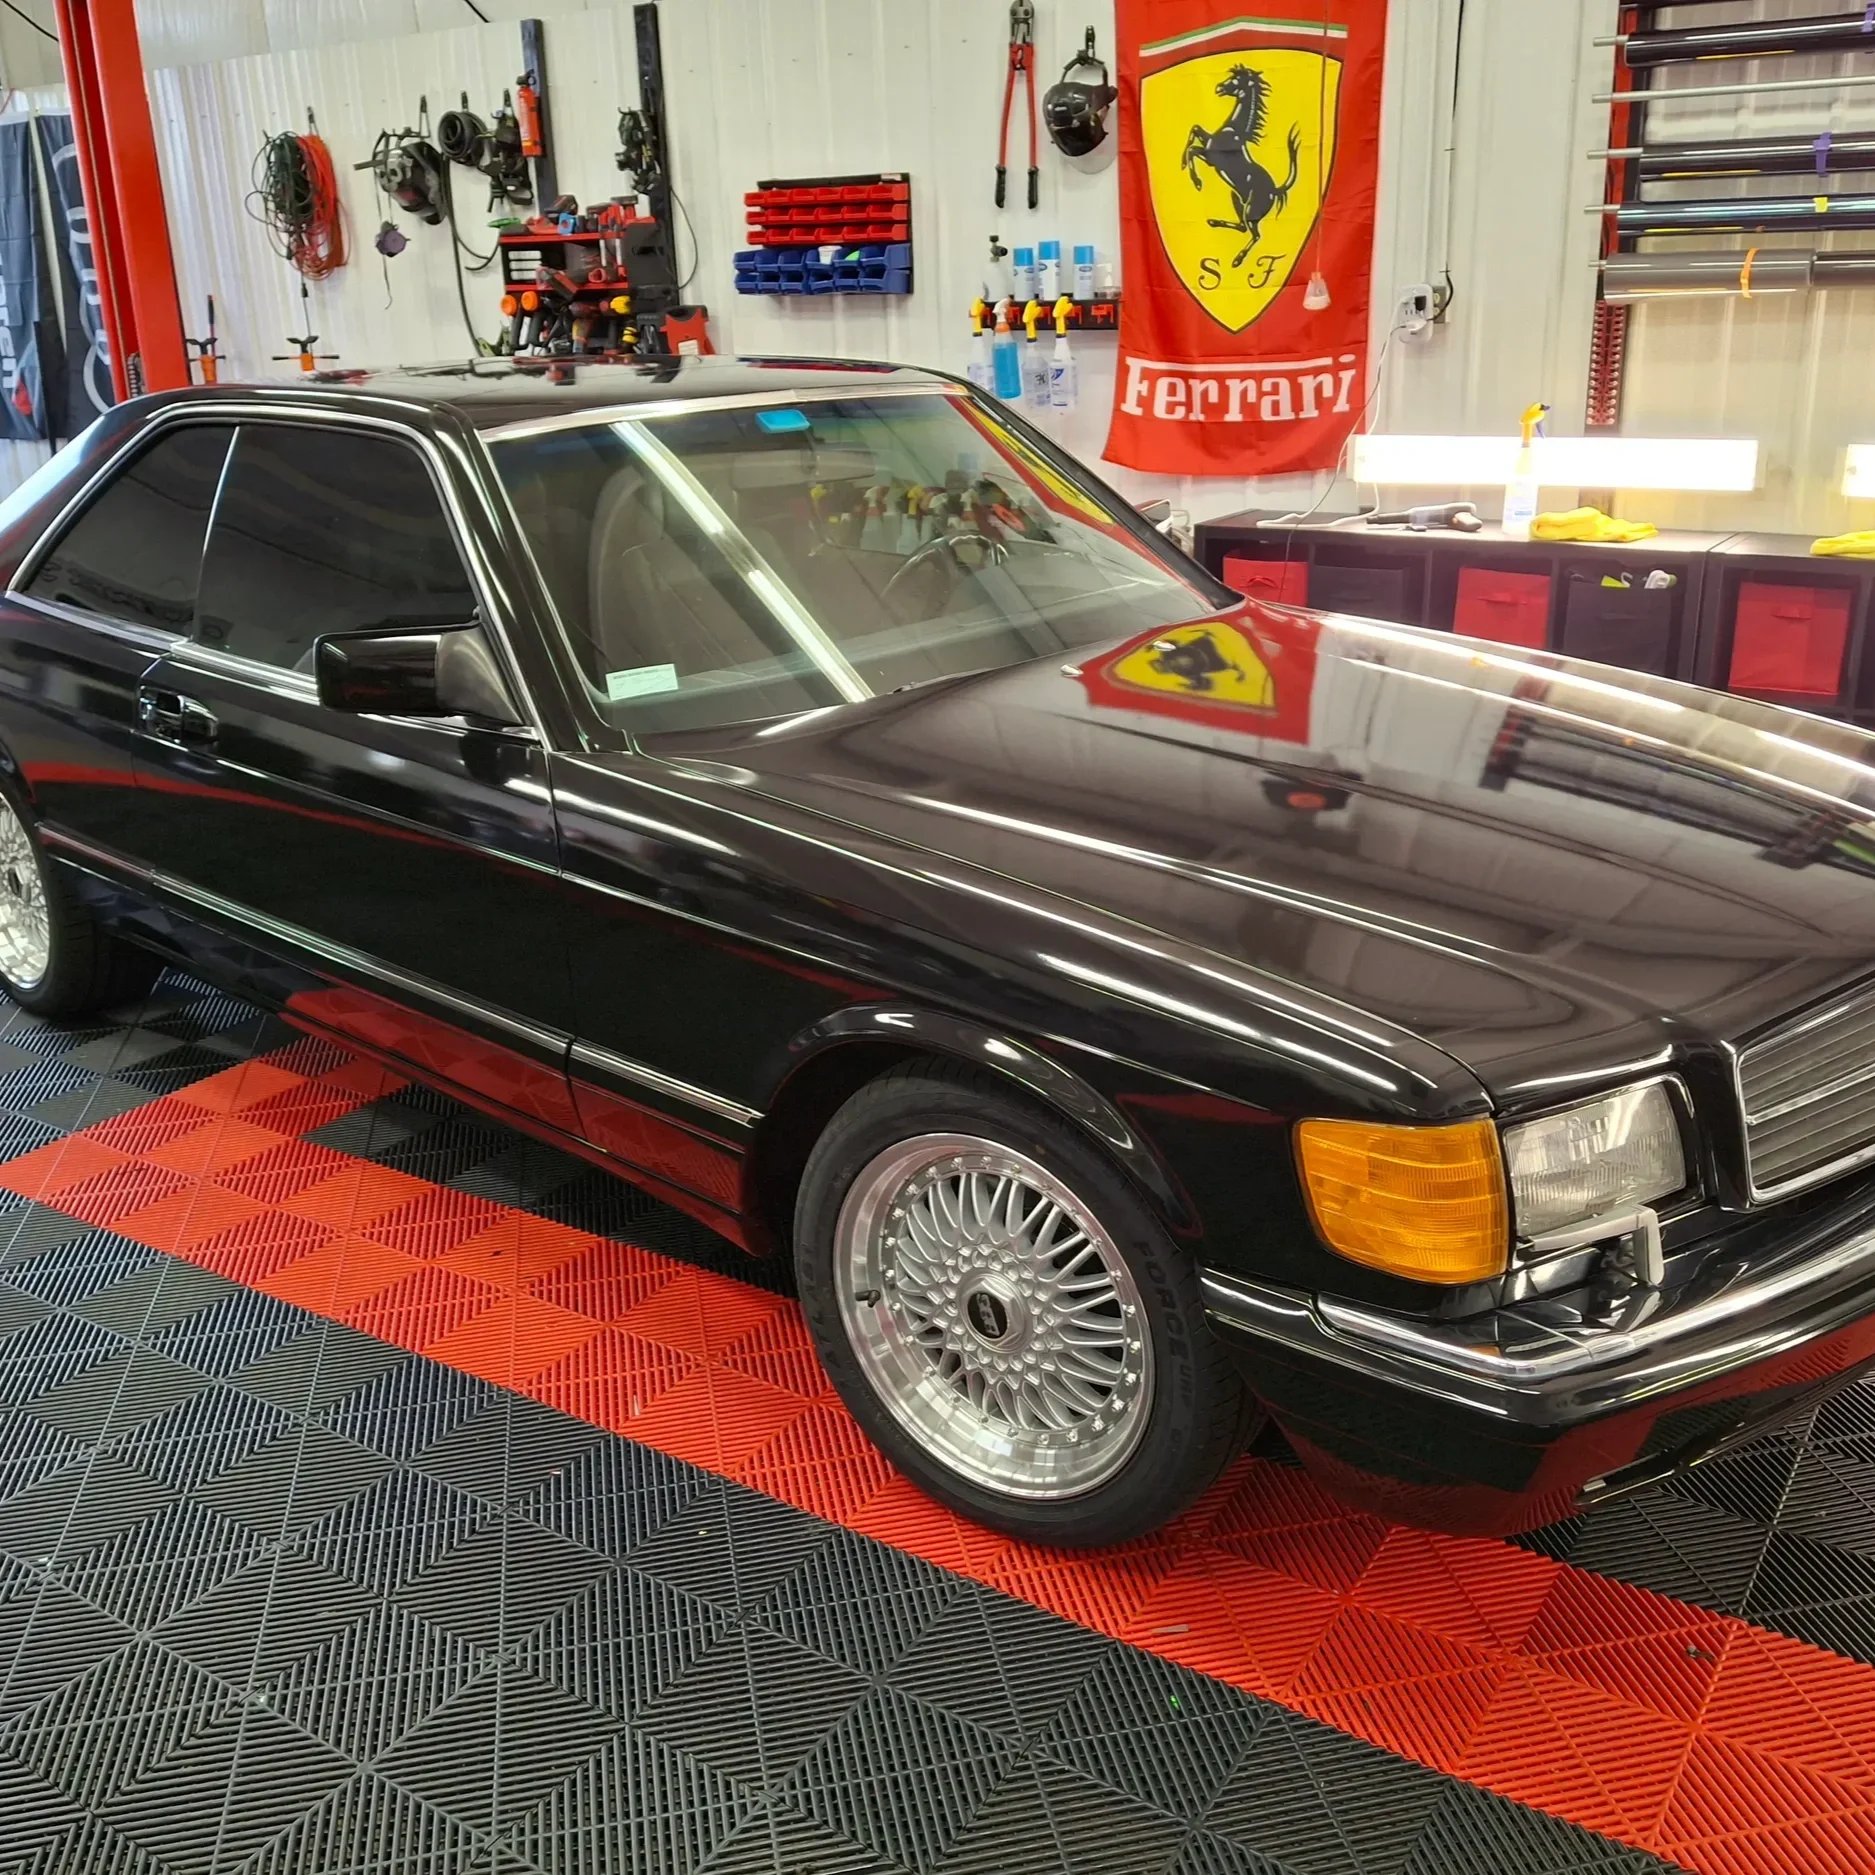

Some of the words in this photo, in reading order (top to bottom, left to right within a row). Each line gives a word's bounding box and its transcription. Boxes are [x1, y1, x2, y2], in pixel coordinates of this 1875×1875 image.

[1198, 257, 1222, 291] S
[1247, 253, 1287, 289] F
[1120, 353, 1356, 422] Ferrari
